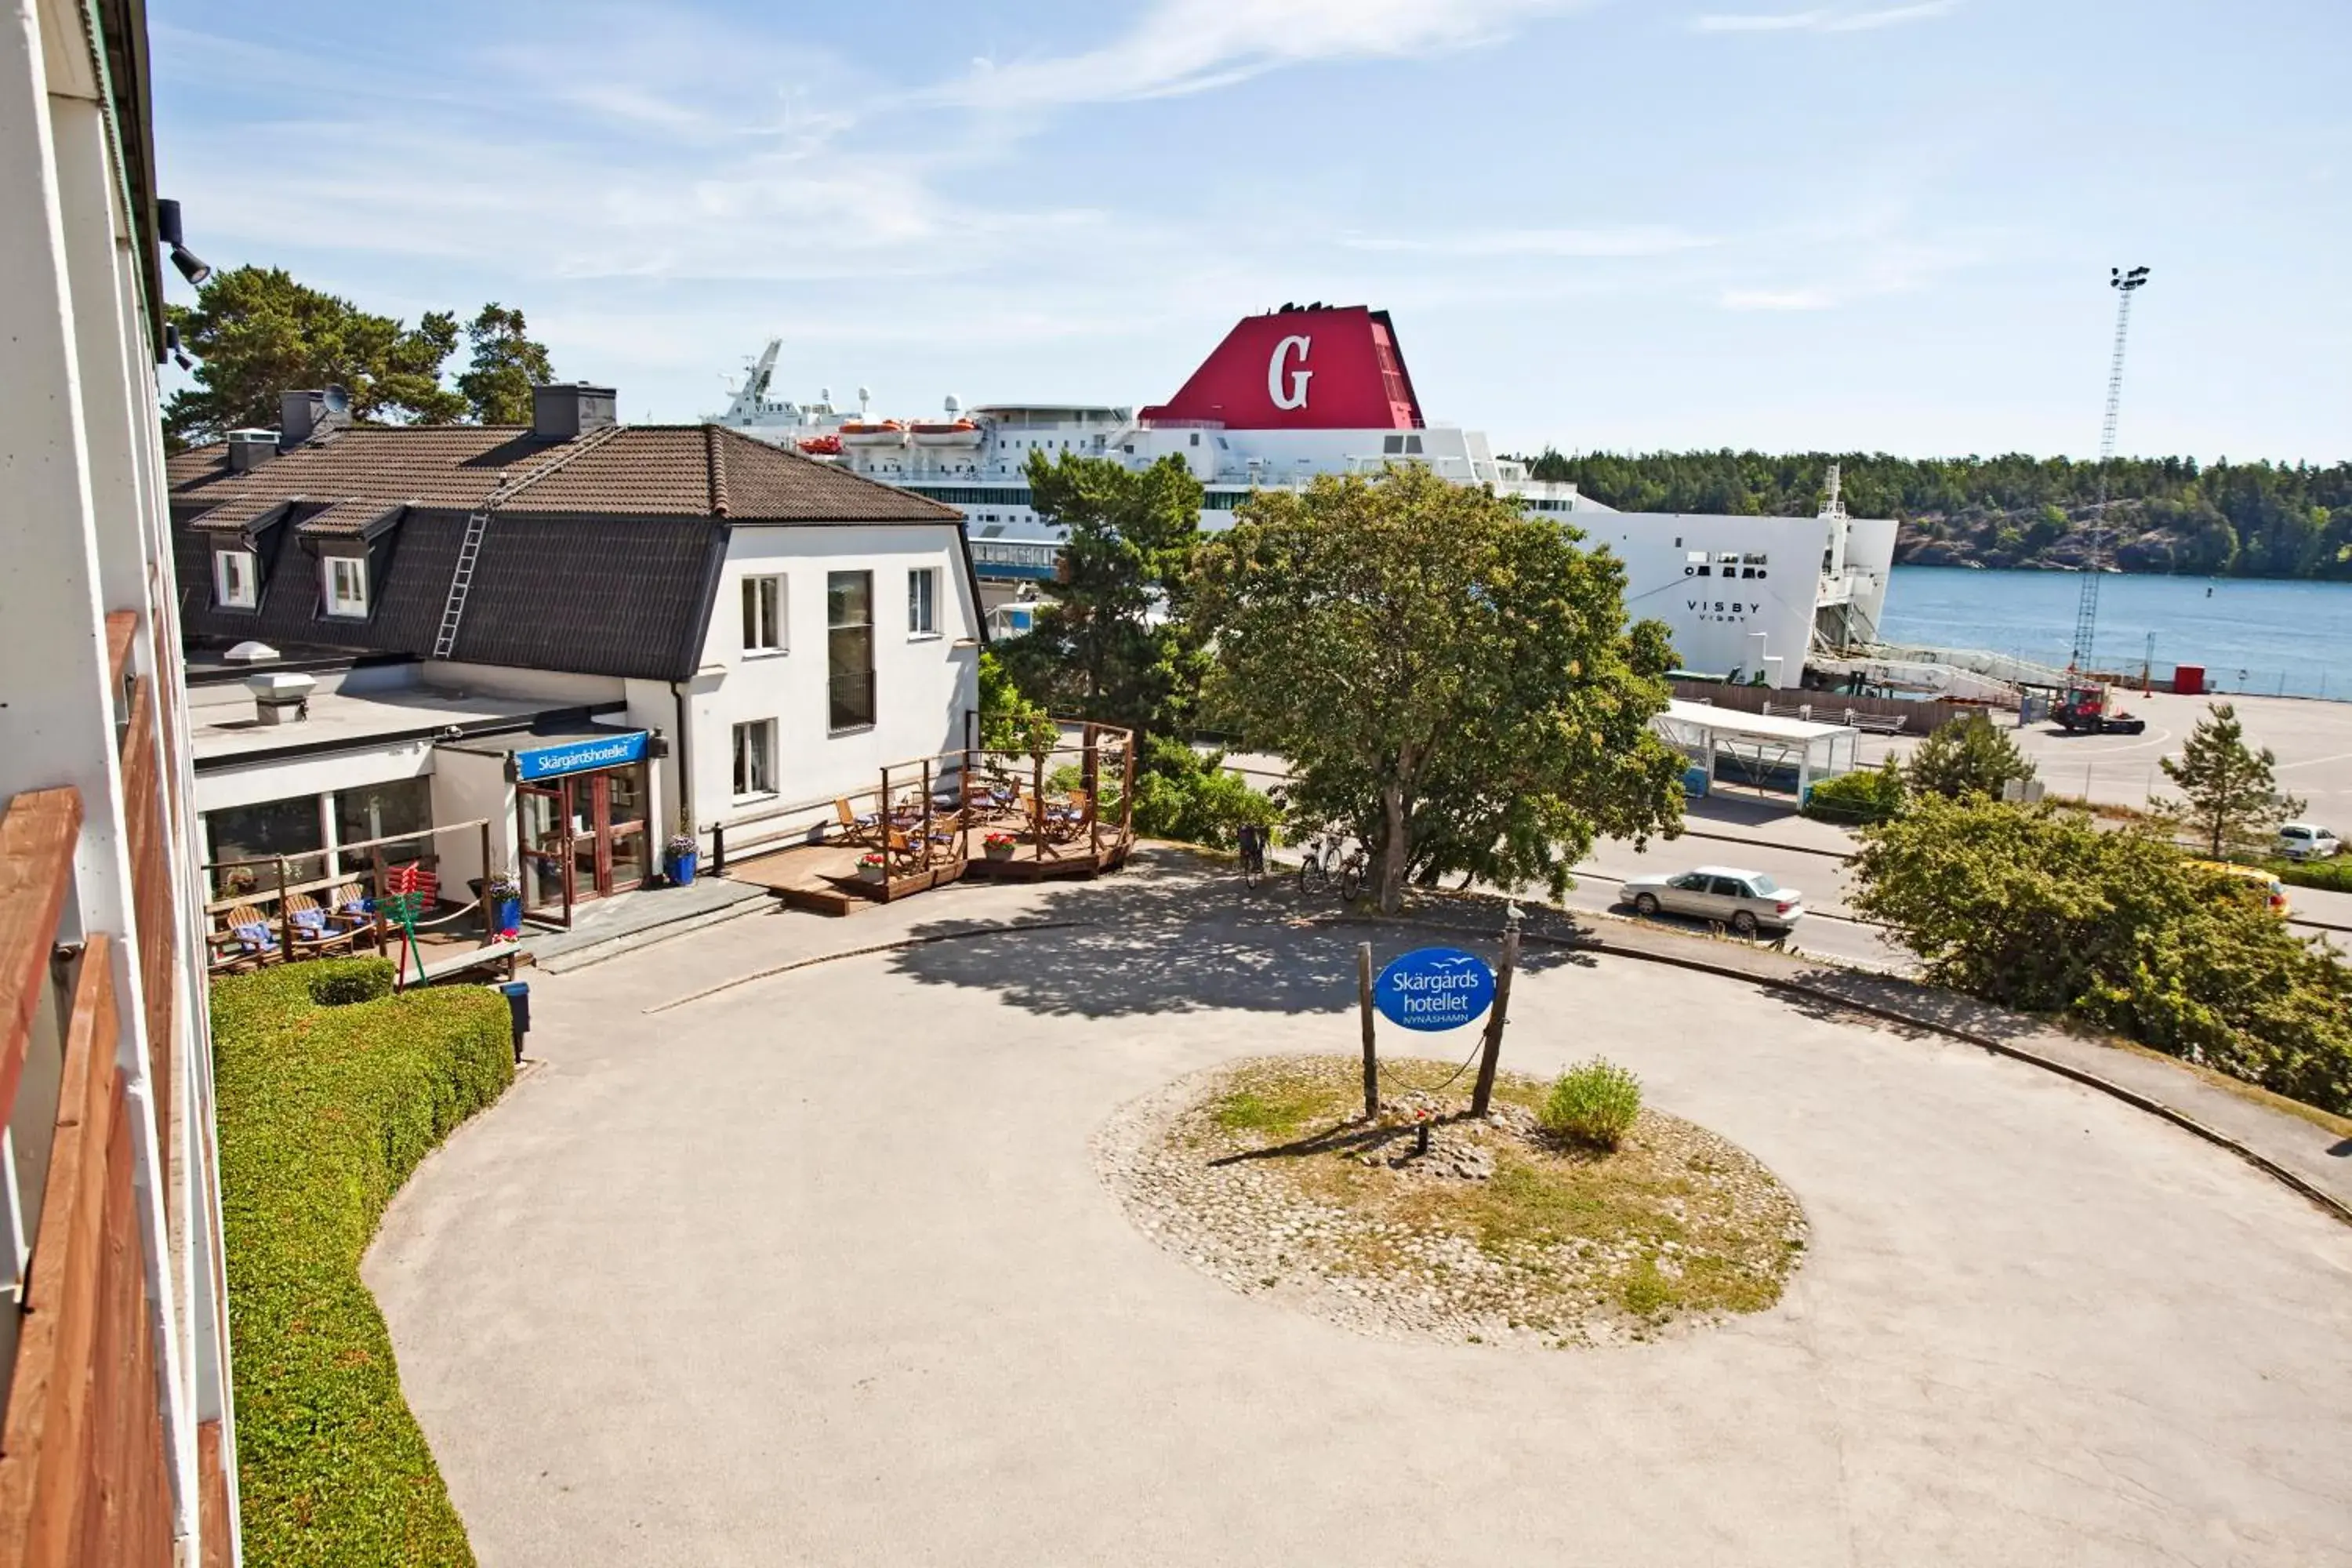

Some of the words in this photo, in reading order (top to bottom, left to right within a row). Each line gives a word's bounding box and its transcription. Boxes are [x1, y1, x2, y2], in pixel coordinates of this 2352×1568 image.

[1268, 335, 1313, 410] G
[755, 404, 791, 412] VISBY
[1687, 601, 1759, 613] VISBY
[538, 744, 628, 771] Skärgårdshotellet
[1392, 970, 1479, 993] Skärgårds
[1404, 994, 1468, 1013] hotellet
